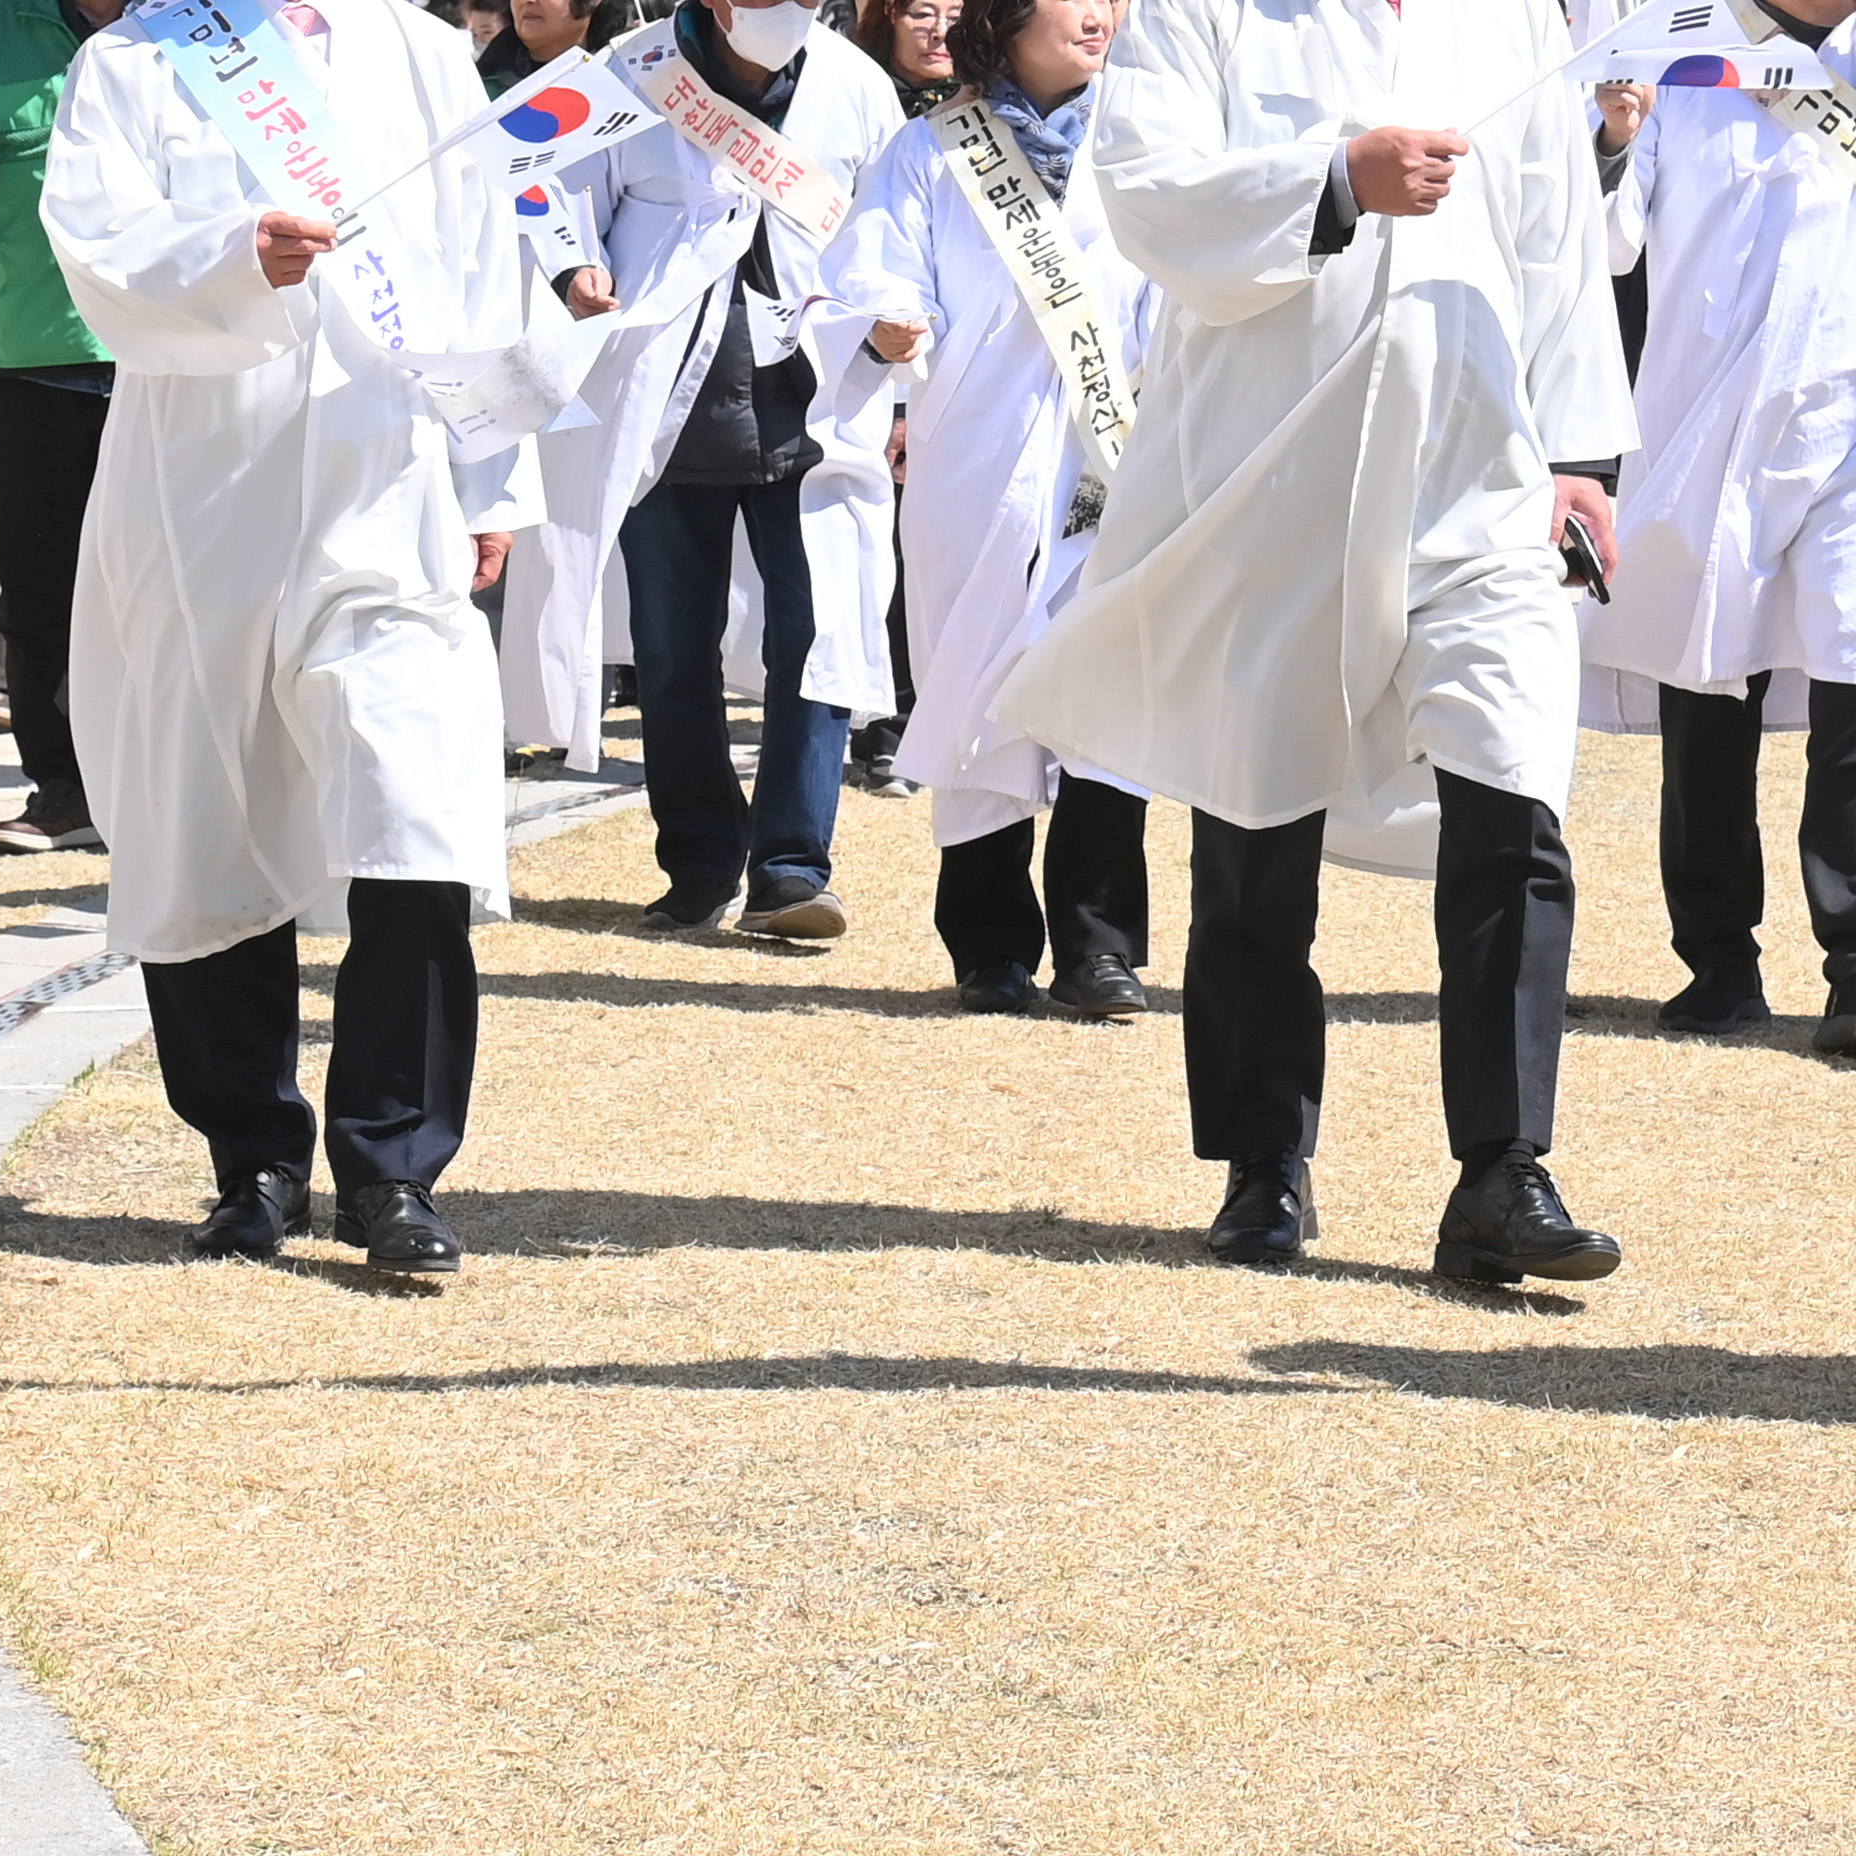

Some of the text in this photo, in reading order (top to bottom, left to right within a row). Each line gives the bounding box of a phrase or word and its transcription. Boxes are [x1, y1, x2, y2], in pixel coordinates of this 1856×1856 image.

[663, 75, 805, 200] 대한독립만세
[946, 105, 1008, 177] 기미년
[986, 175, 1084, 310] 만세운동은
[353, 249, 404, 351] 사천정
